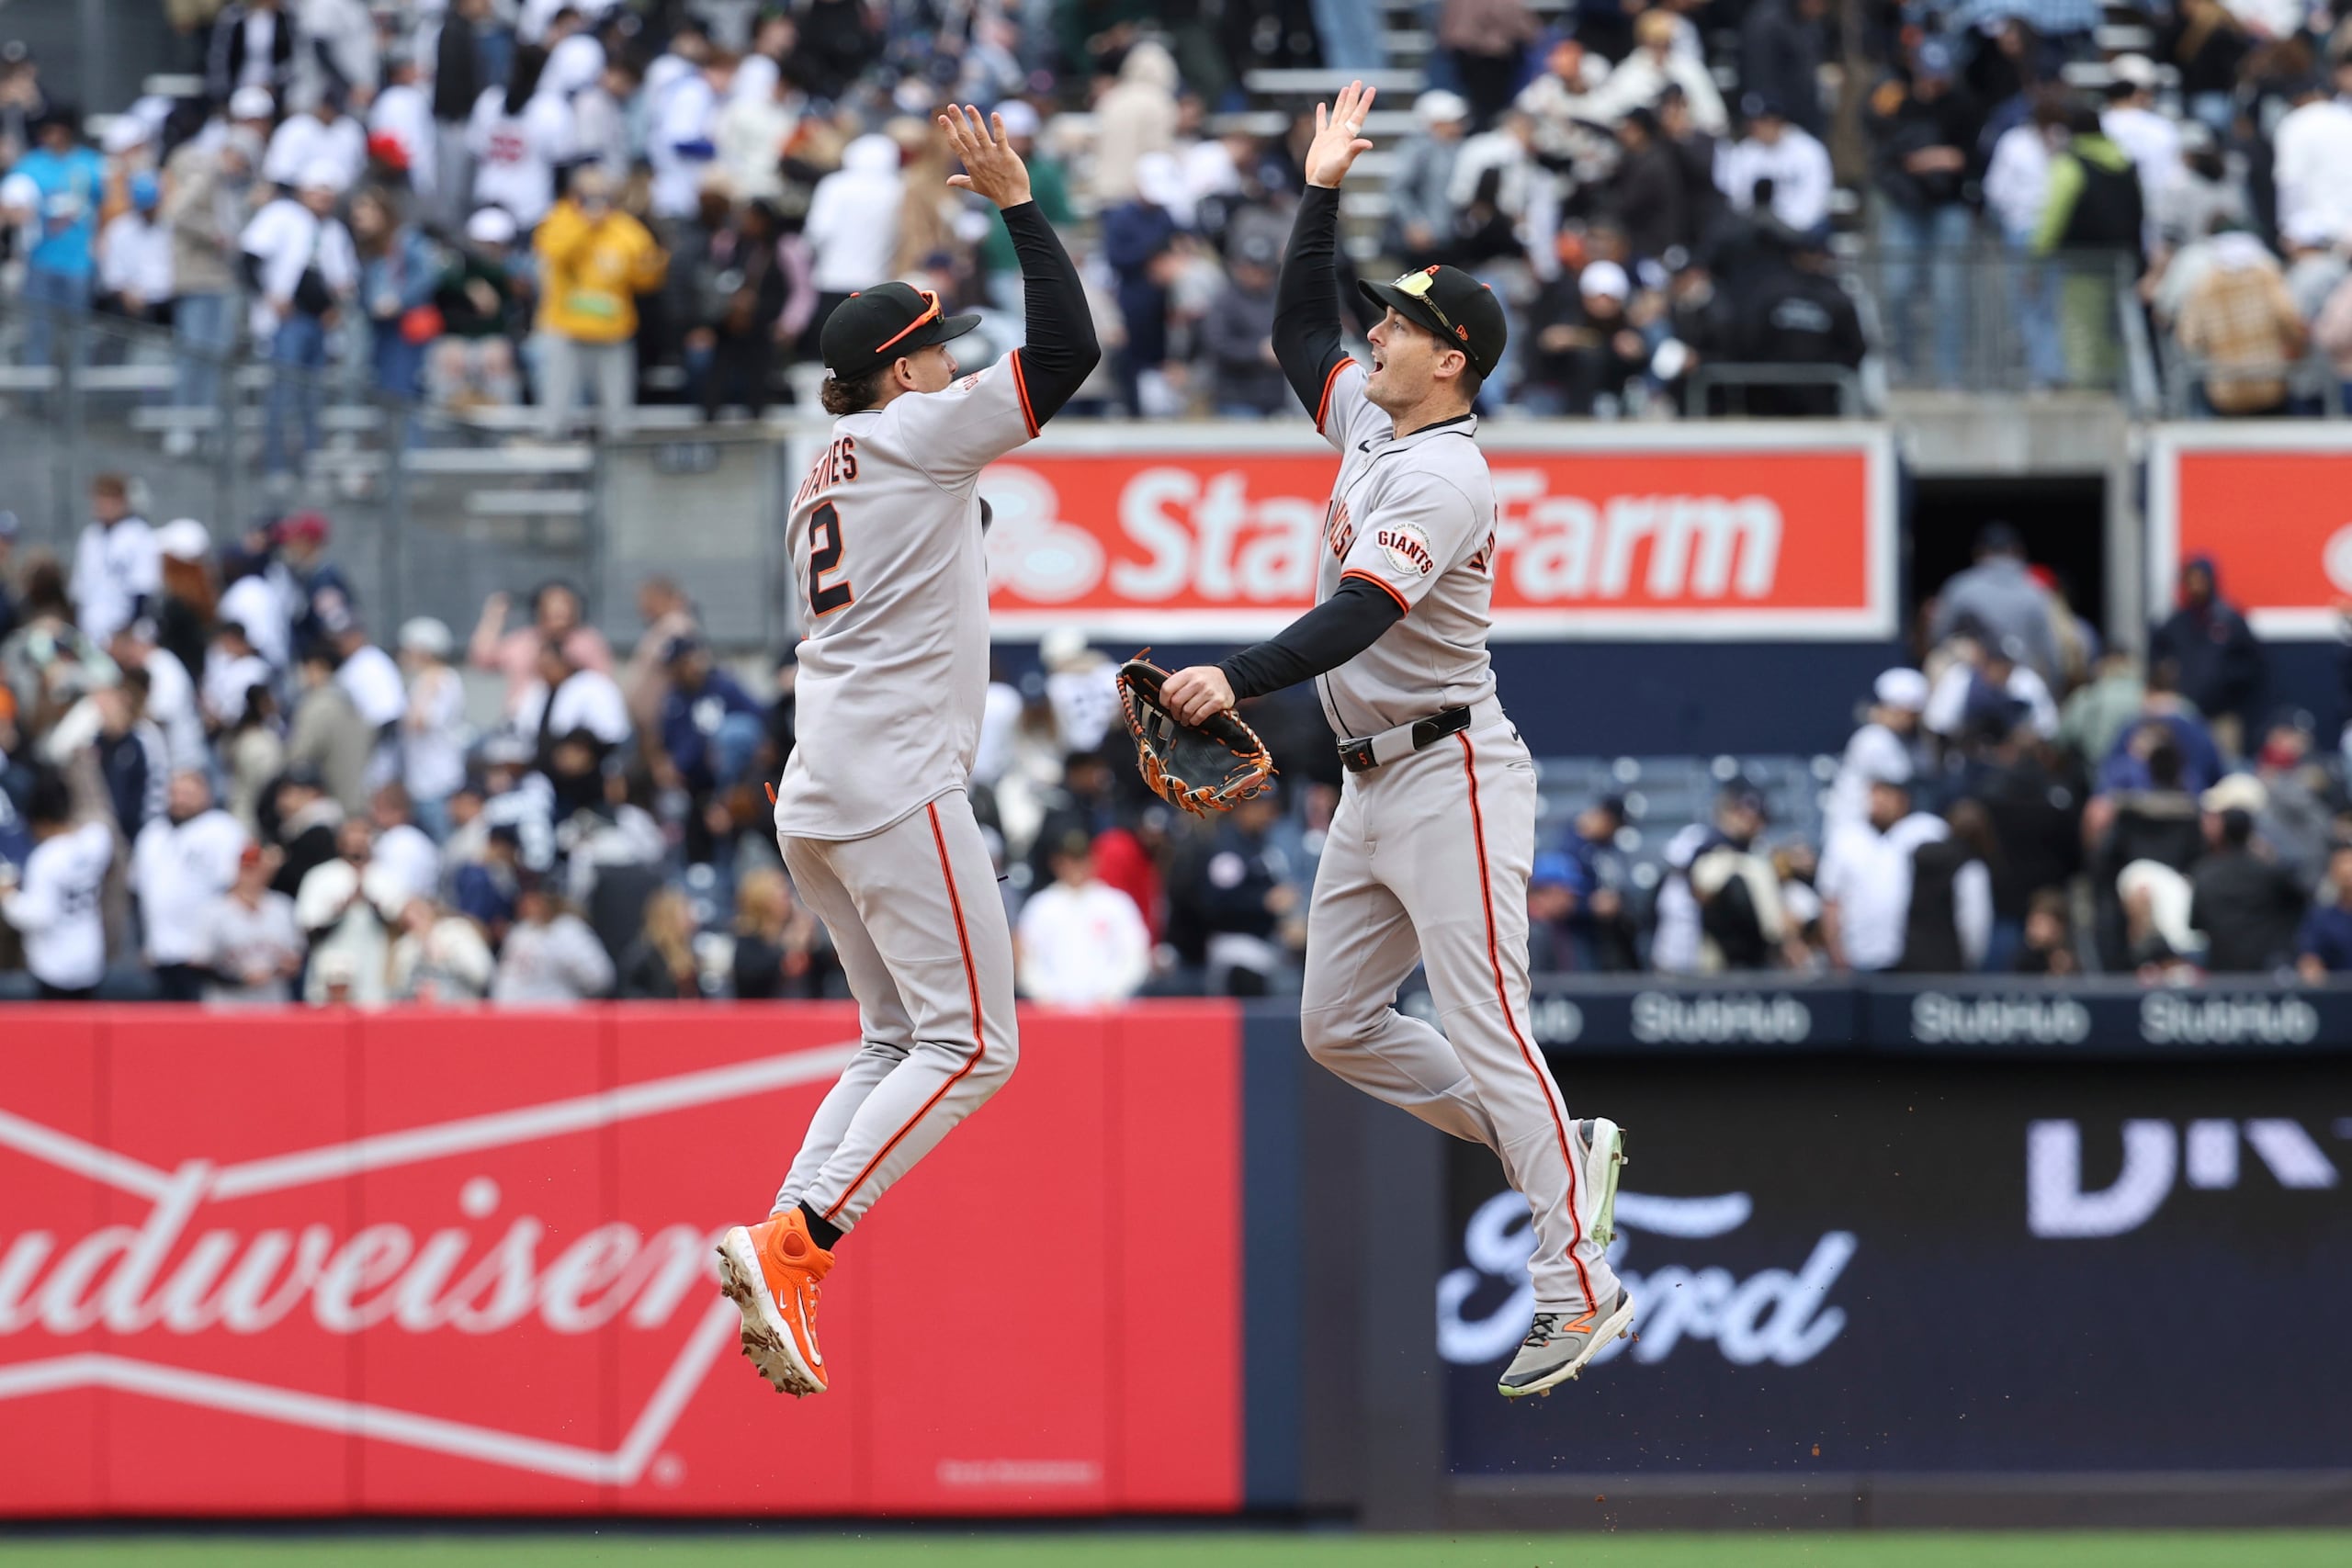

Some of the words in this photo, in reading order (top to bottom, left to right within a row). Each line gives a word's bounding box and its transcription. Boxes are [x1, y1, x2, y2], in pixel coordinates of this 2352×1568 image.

[808, 501, 855, 617] 2
[1377, 530, 1433, 574] GIANTS
[1632, 991, 1810, 1043] StubHub
[1912, 991, 2090, 1043] StubHub
[2142, 991, 2318, 1043] StubHub
